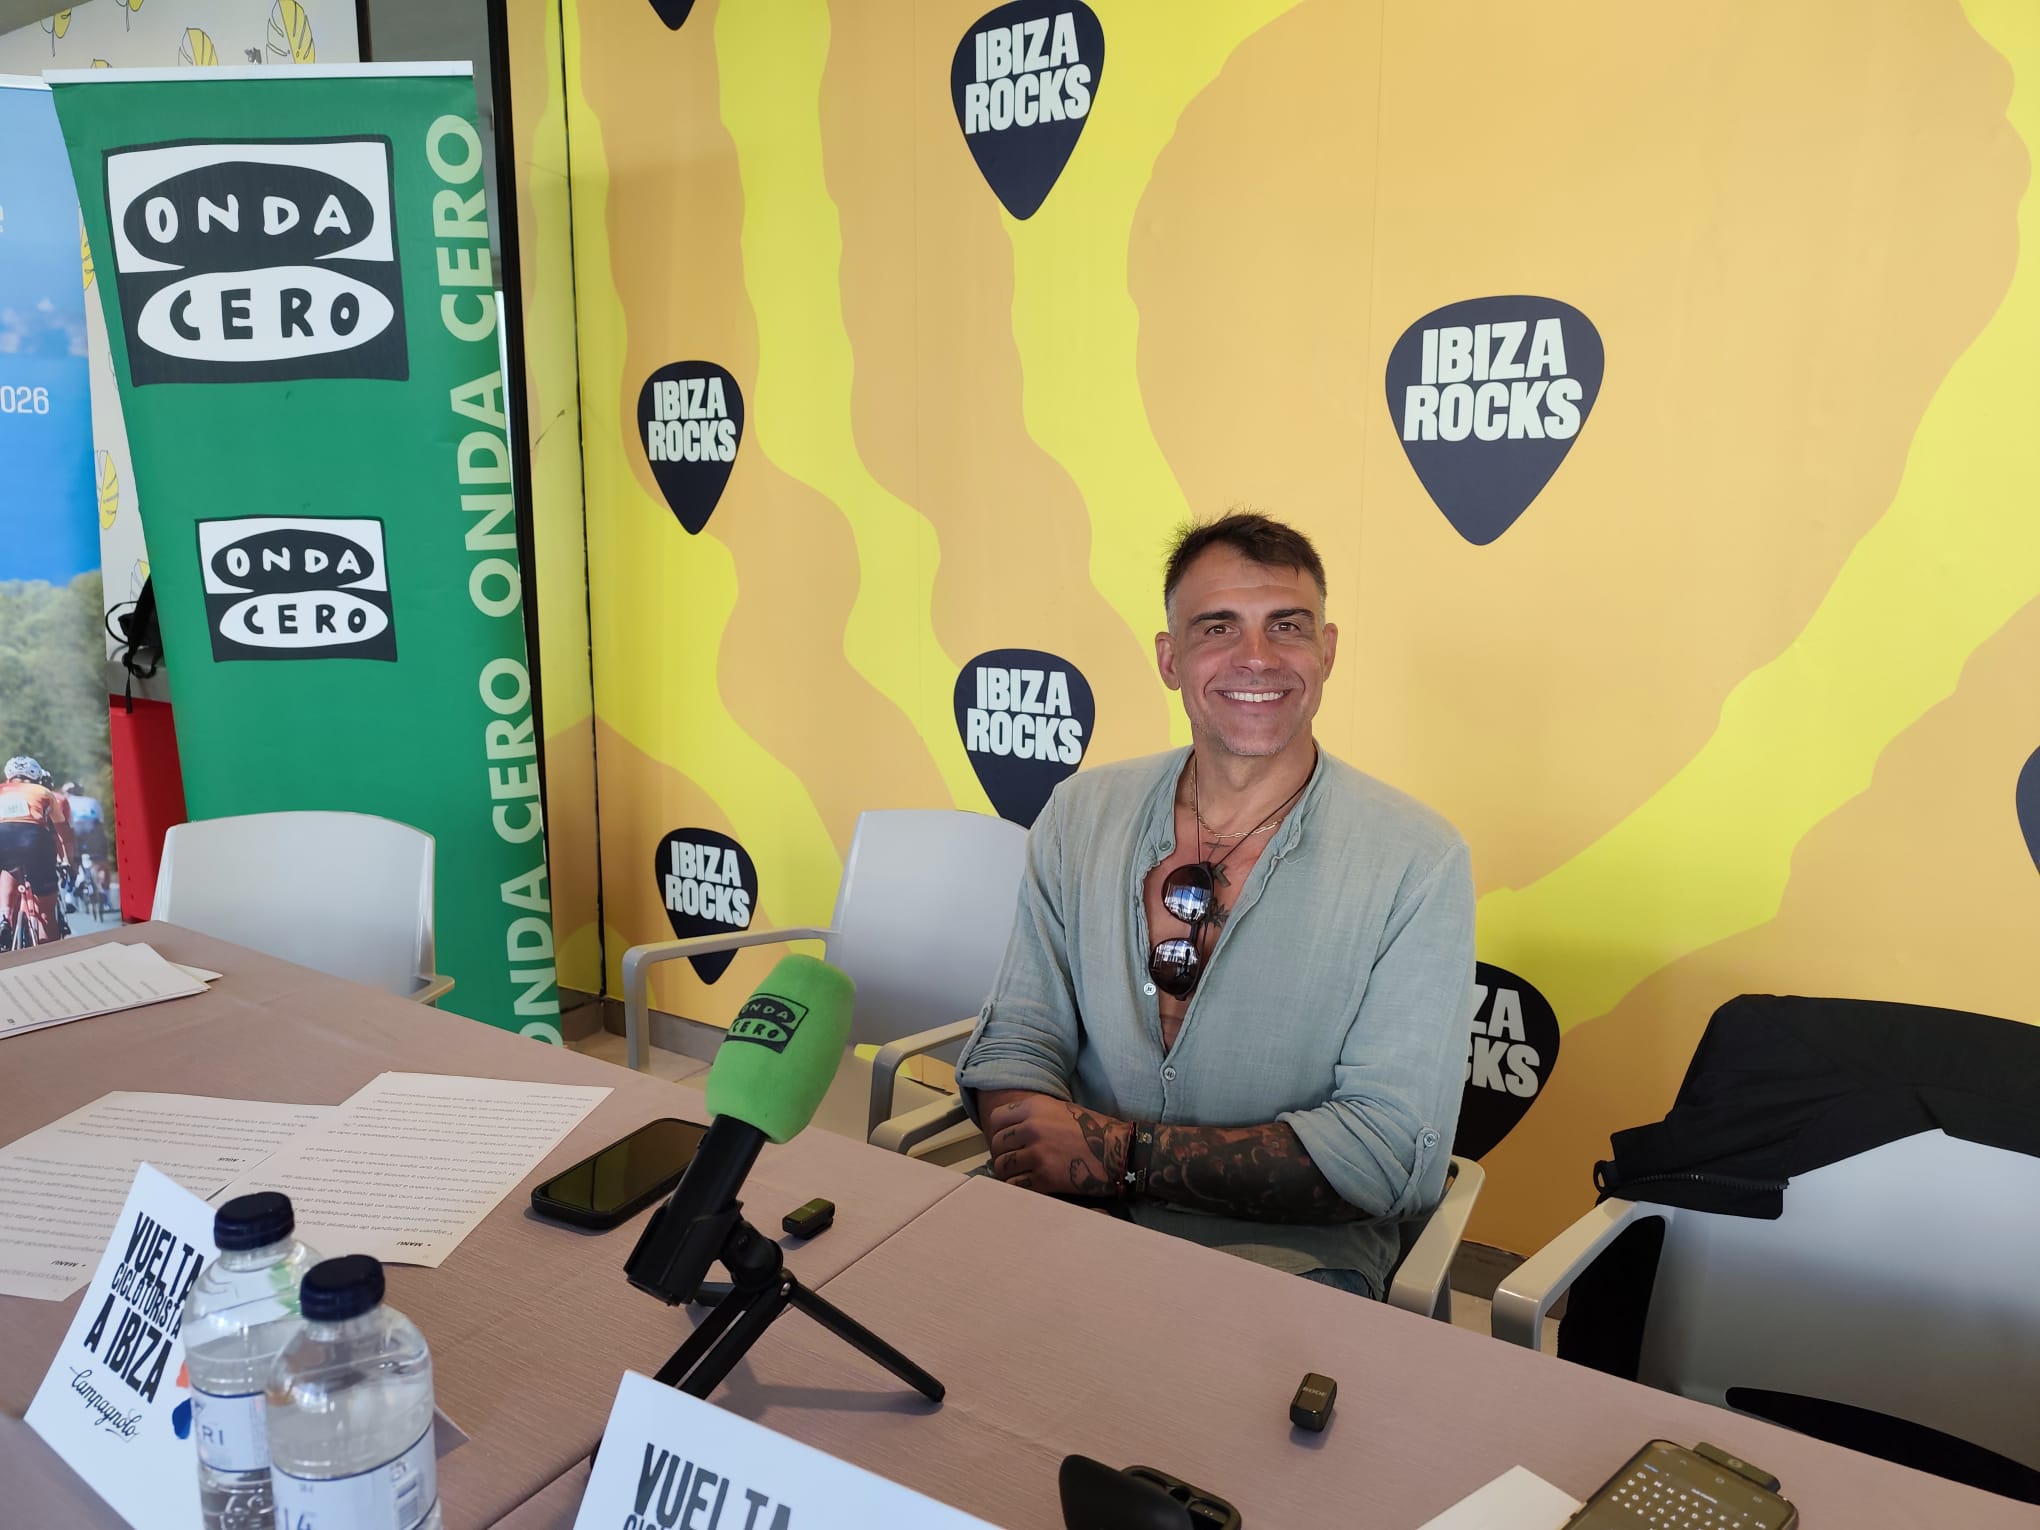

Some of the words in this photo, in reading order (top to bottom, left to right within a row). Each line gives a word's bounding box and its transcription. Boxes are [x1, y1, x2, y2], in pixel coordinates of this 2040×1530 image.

[975, 12, 1079, 83] IBIZA
[965, 64, 1091, 135] ROCKS
[145, 194, 351, 243] ONDA
[426, 115, 497, 341] CERO
[169, 288, 360, 341] CERO
[1421, 318, 1567, 384] IBIZA
[653, 377, 727, 421] IBIZA
[1403, 378, 1583, 441] ROCKS
[648, 418, 736, 463] ROCKS
[450, 370, 522, 618] ONDA
[226, 546, 362, 577] ONDA
[243, 603, 367, 634] CERO
[976, 667, 1072, 716] IBIZA
[479, 658, 543, 844] CERO
[966, 708, 1083, 765] ROCKS
[671, 841, 742, 888] IBIZA
[665, 875, 750, 928] ROCKS
[1465, 1036, 1540, 1098] KS
[124, 1211, 204, 1303] VUELTA
[84, 1293, 115, 1353] A
[103, 1307, 172, 1404] IBIZA
[69, 1366, 142, 1443] Campagnolo
